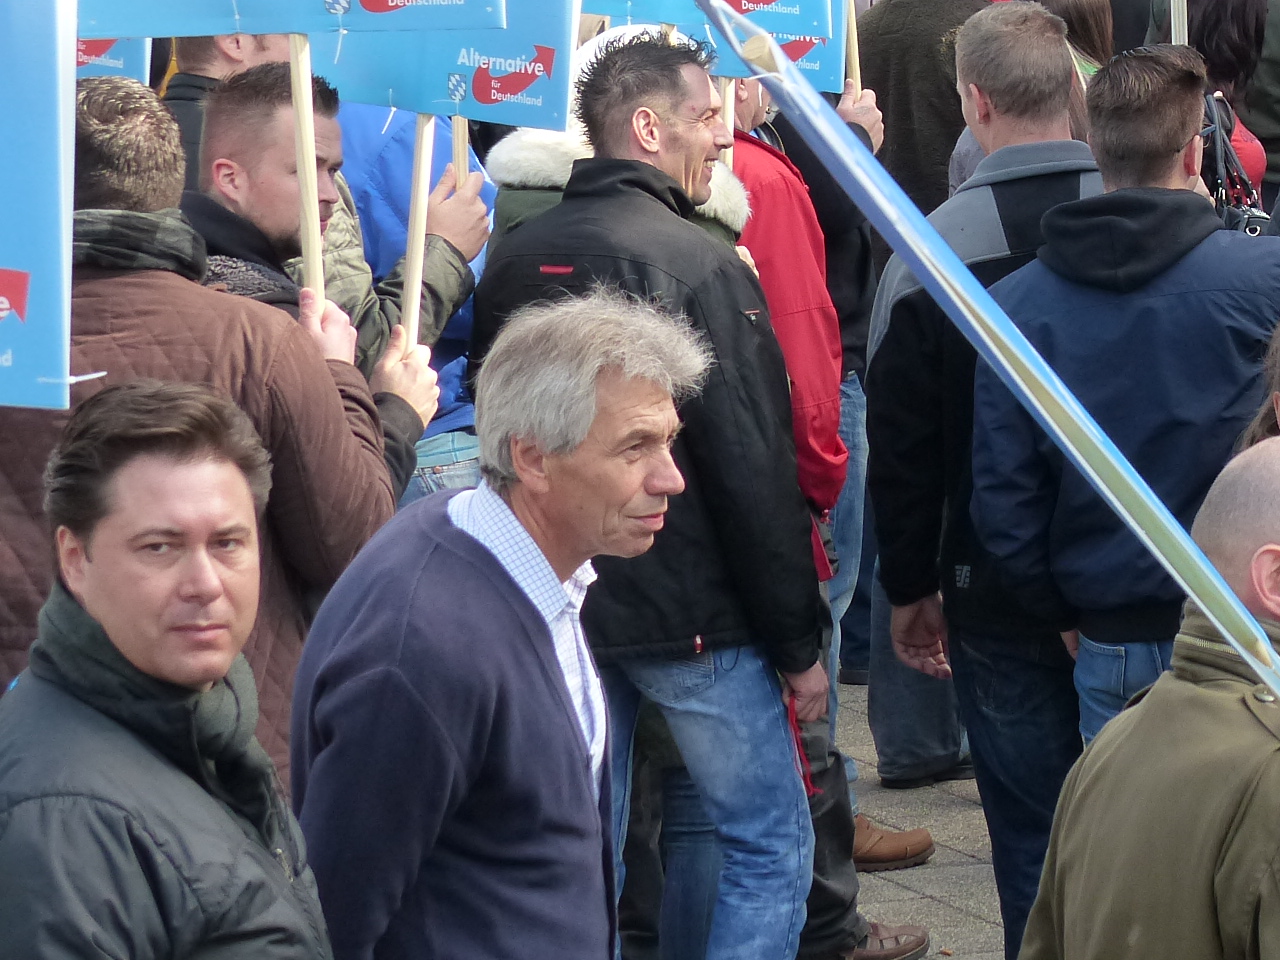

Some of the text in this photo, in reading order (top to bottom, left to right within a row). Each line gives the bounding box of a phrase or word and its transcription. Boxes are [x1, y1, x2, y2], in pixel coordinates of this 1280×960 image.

[742, 0, 800, 15] Deutschland
[457, 48, 544, 76] Alternative
[491, 80, 501, 89] für
[491, 90, 542, 107] Deutschland
